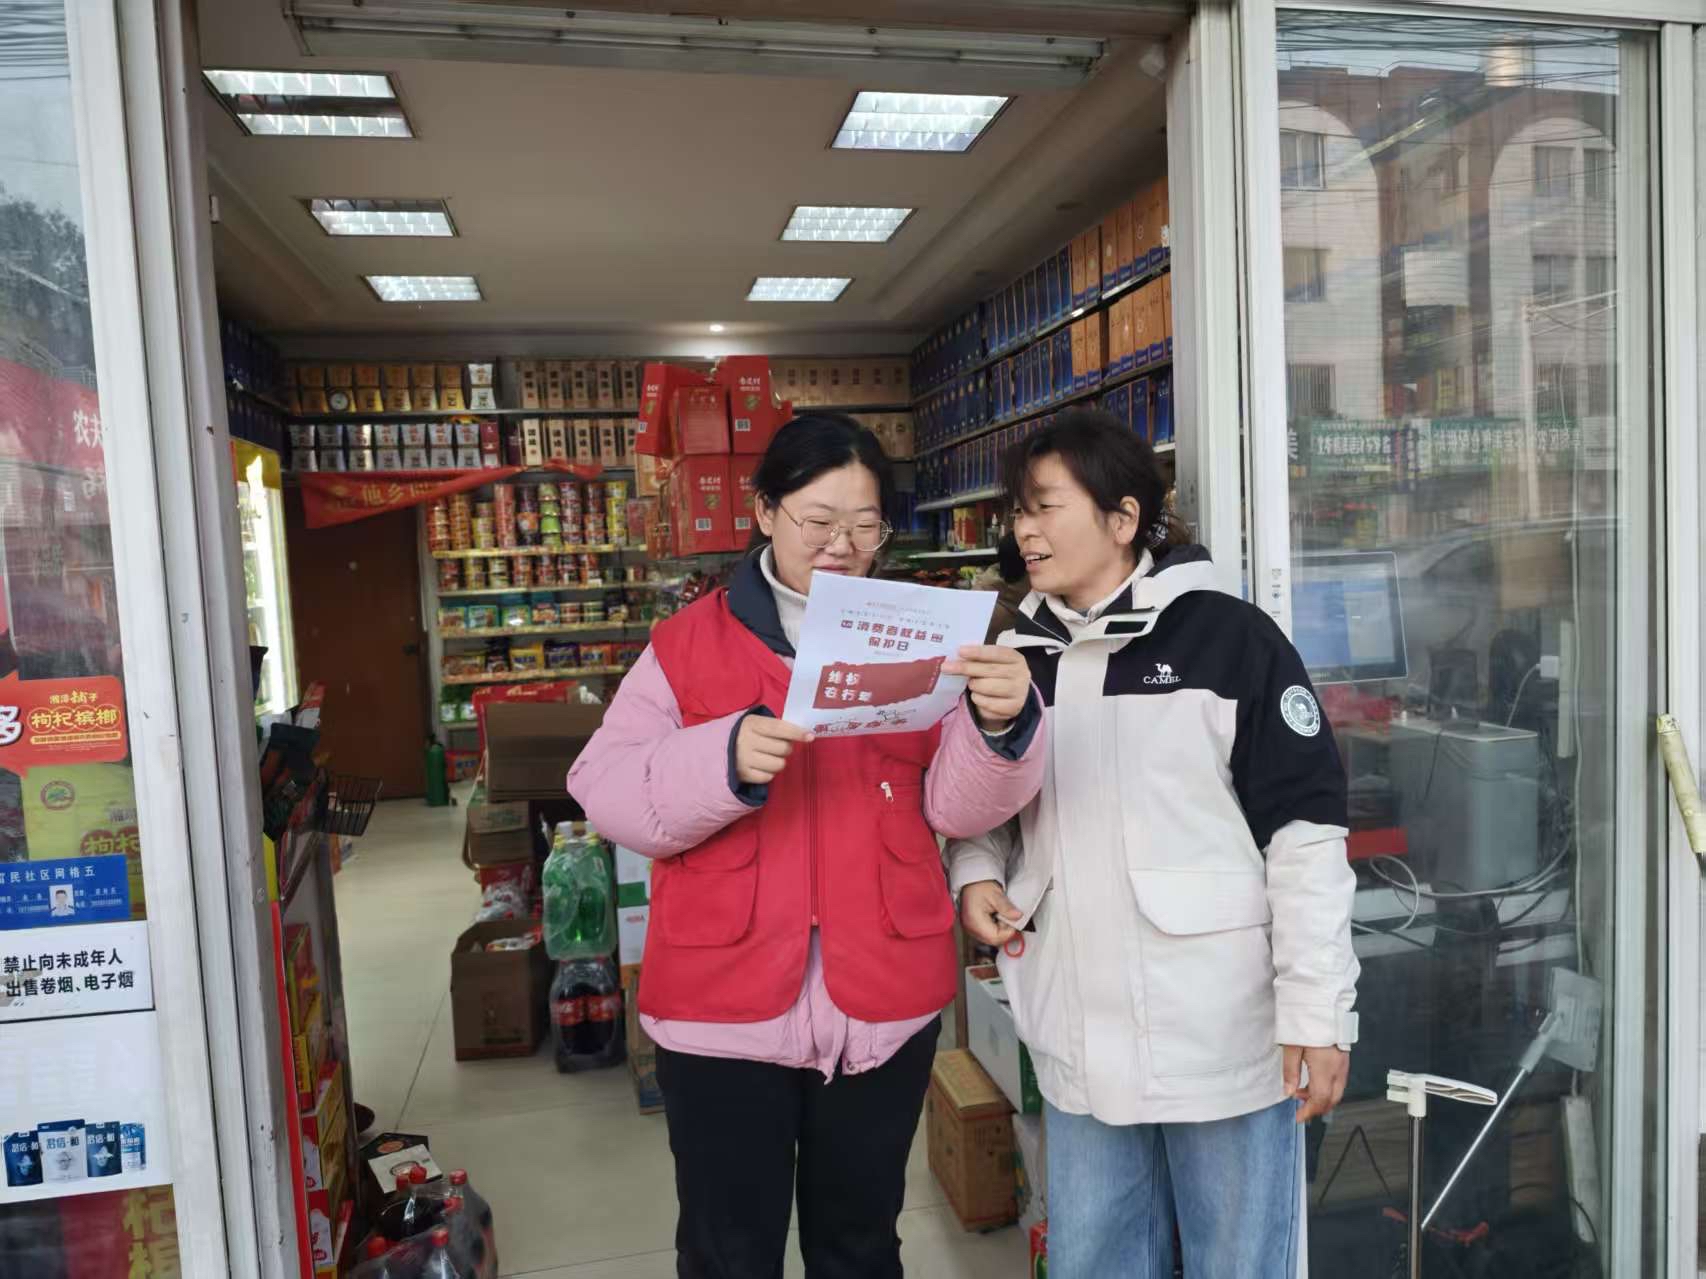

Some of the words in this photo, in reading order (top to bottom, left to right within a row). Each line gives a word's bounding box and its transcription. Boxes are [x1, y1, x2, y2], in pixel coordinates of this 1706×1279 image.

[1143, 675, 1182, 686] CAMEL
[30, 708, 118, 729] 枸杞槟榔
[3, 947, 124, 974] 禁止向未成年人
[5, 970, 135, 998] 出售卷烟、电子烟
